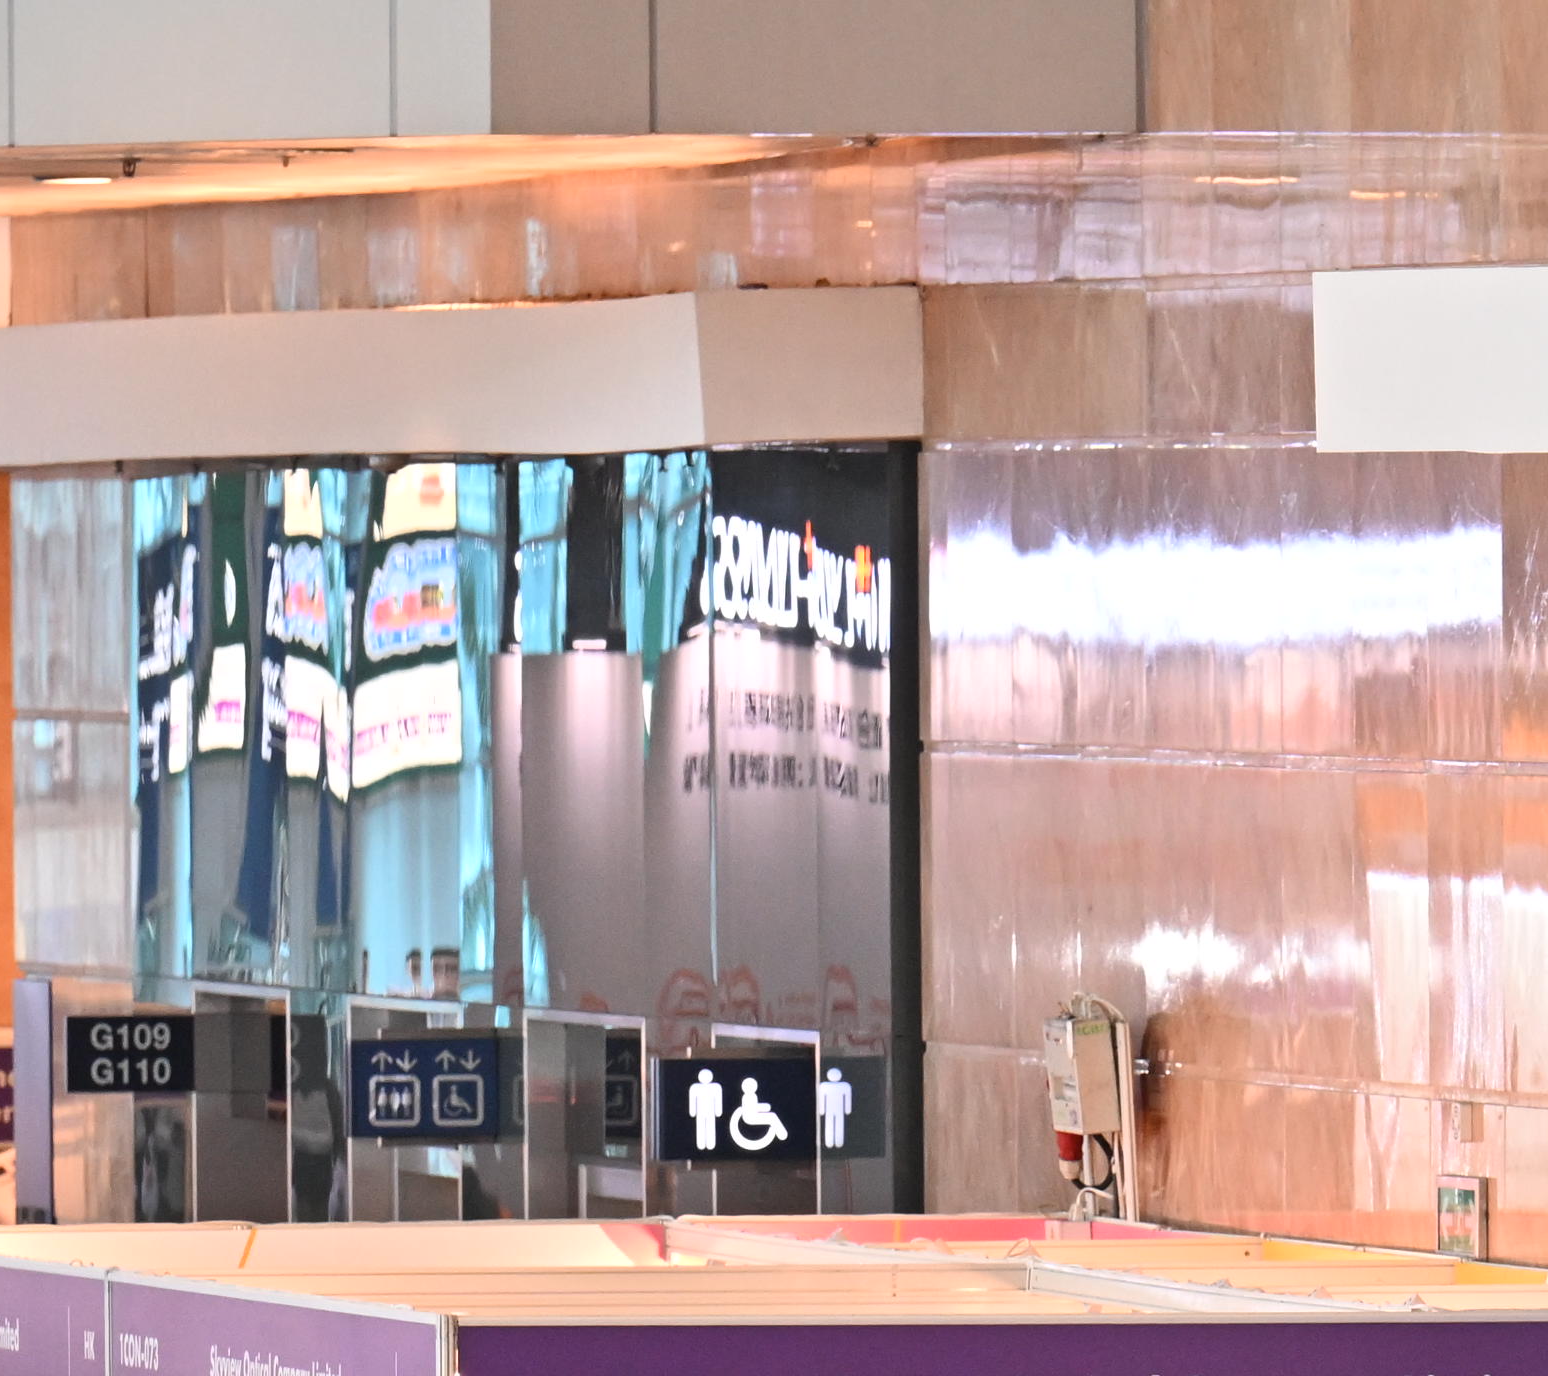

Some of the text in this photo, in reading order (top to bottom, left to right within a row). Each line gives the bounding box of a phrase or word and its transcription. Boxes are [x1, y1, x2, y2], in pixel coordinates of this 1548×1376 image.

[89, 1022, 171, 1057] G109
[89, 1057, 172, 1092] G110
[83, 1329, 95, 1361] HK
[119, 1332, 159, 1372] 1CON-073
